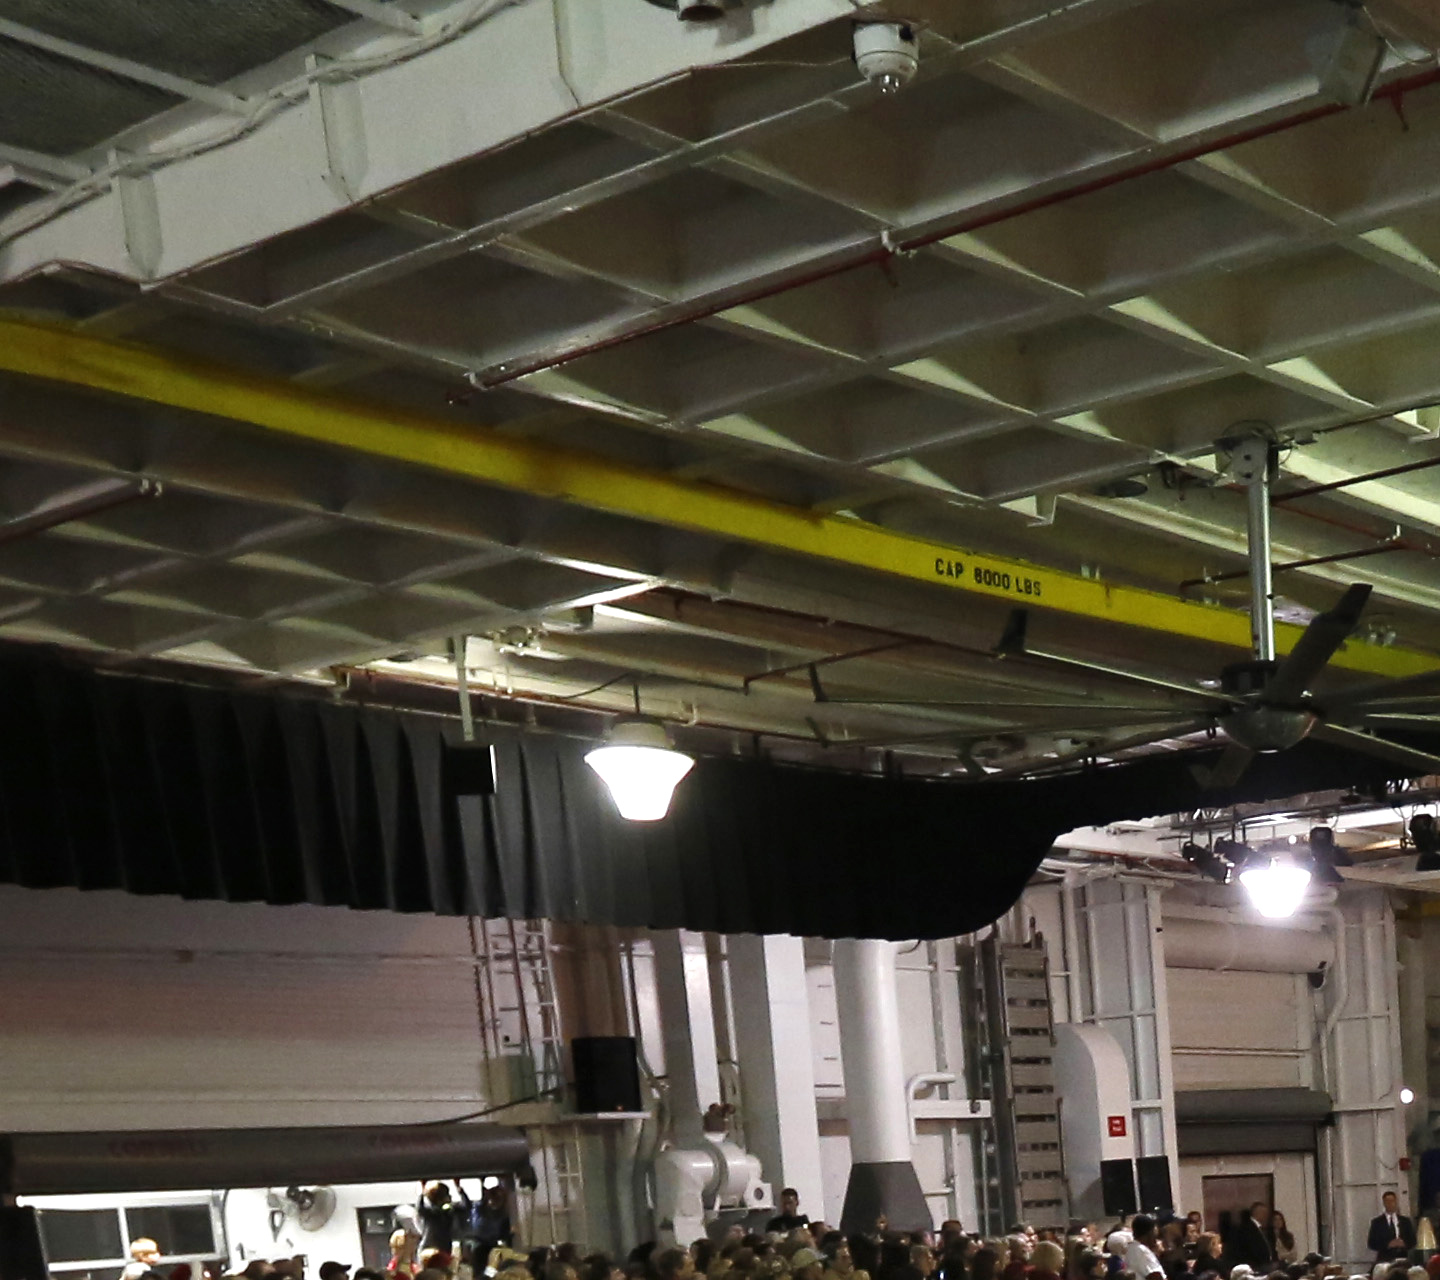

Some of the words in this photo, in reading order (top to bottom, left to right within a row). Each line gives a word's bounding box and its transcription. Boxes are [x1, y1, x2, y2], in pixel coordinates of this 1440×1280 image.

[935, 558, 965, 581] CAP
[974, 567, 1011, 590] 8000
[1015, 576, 1042, 597] LBS
